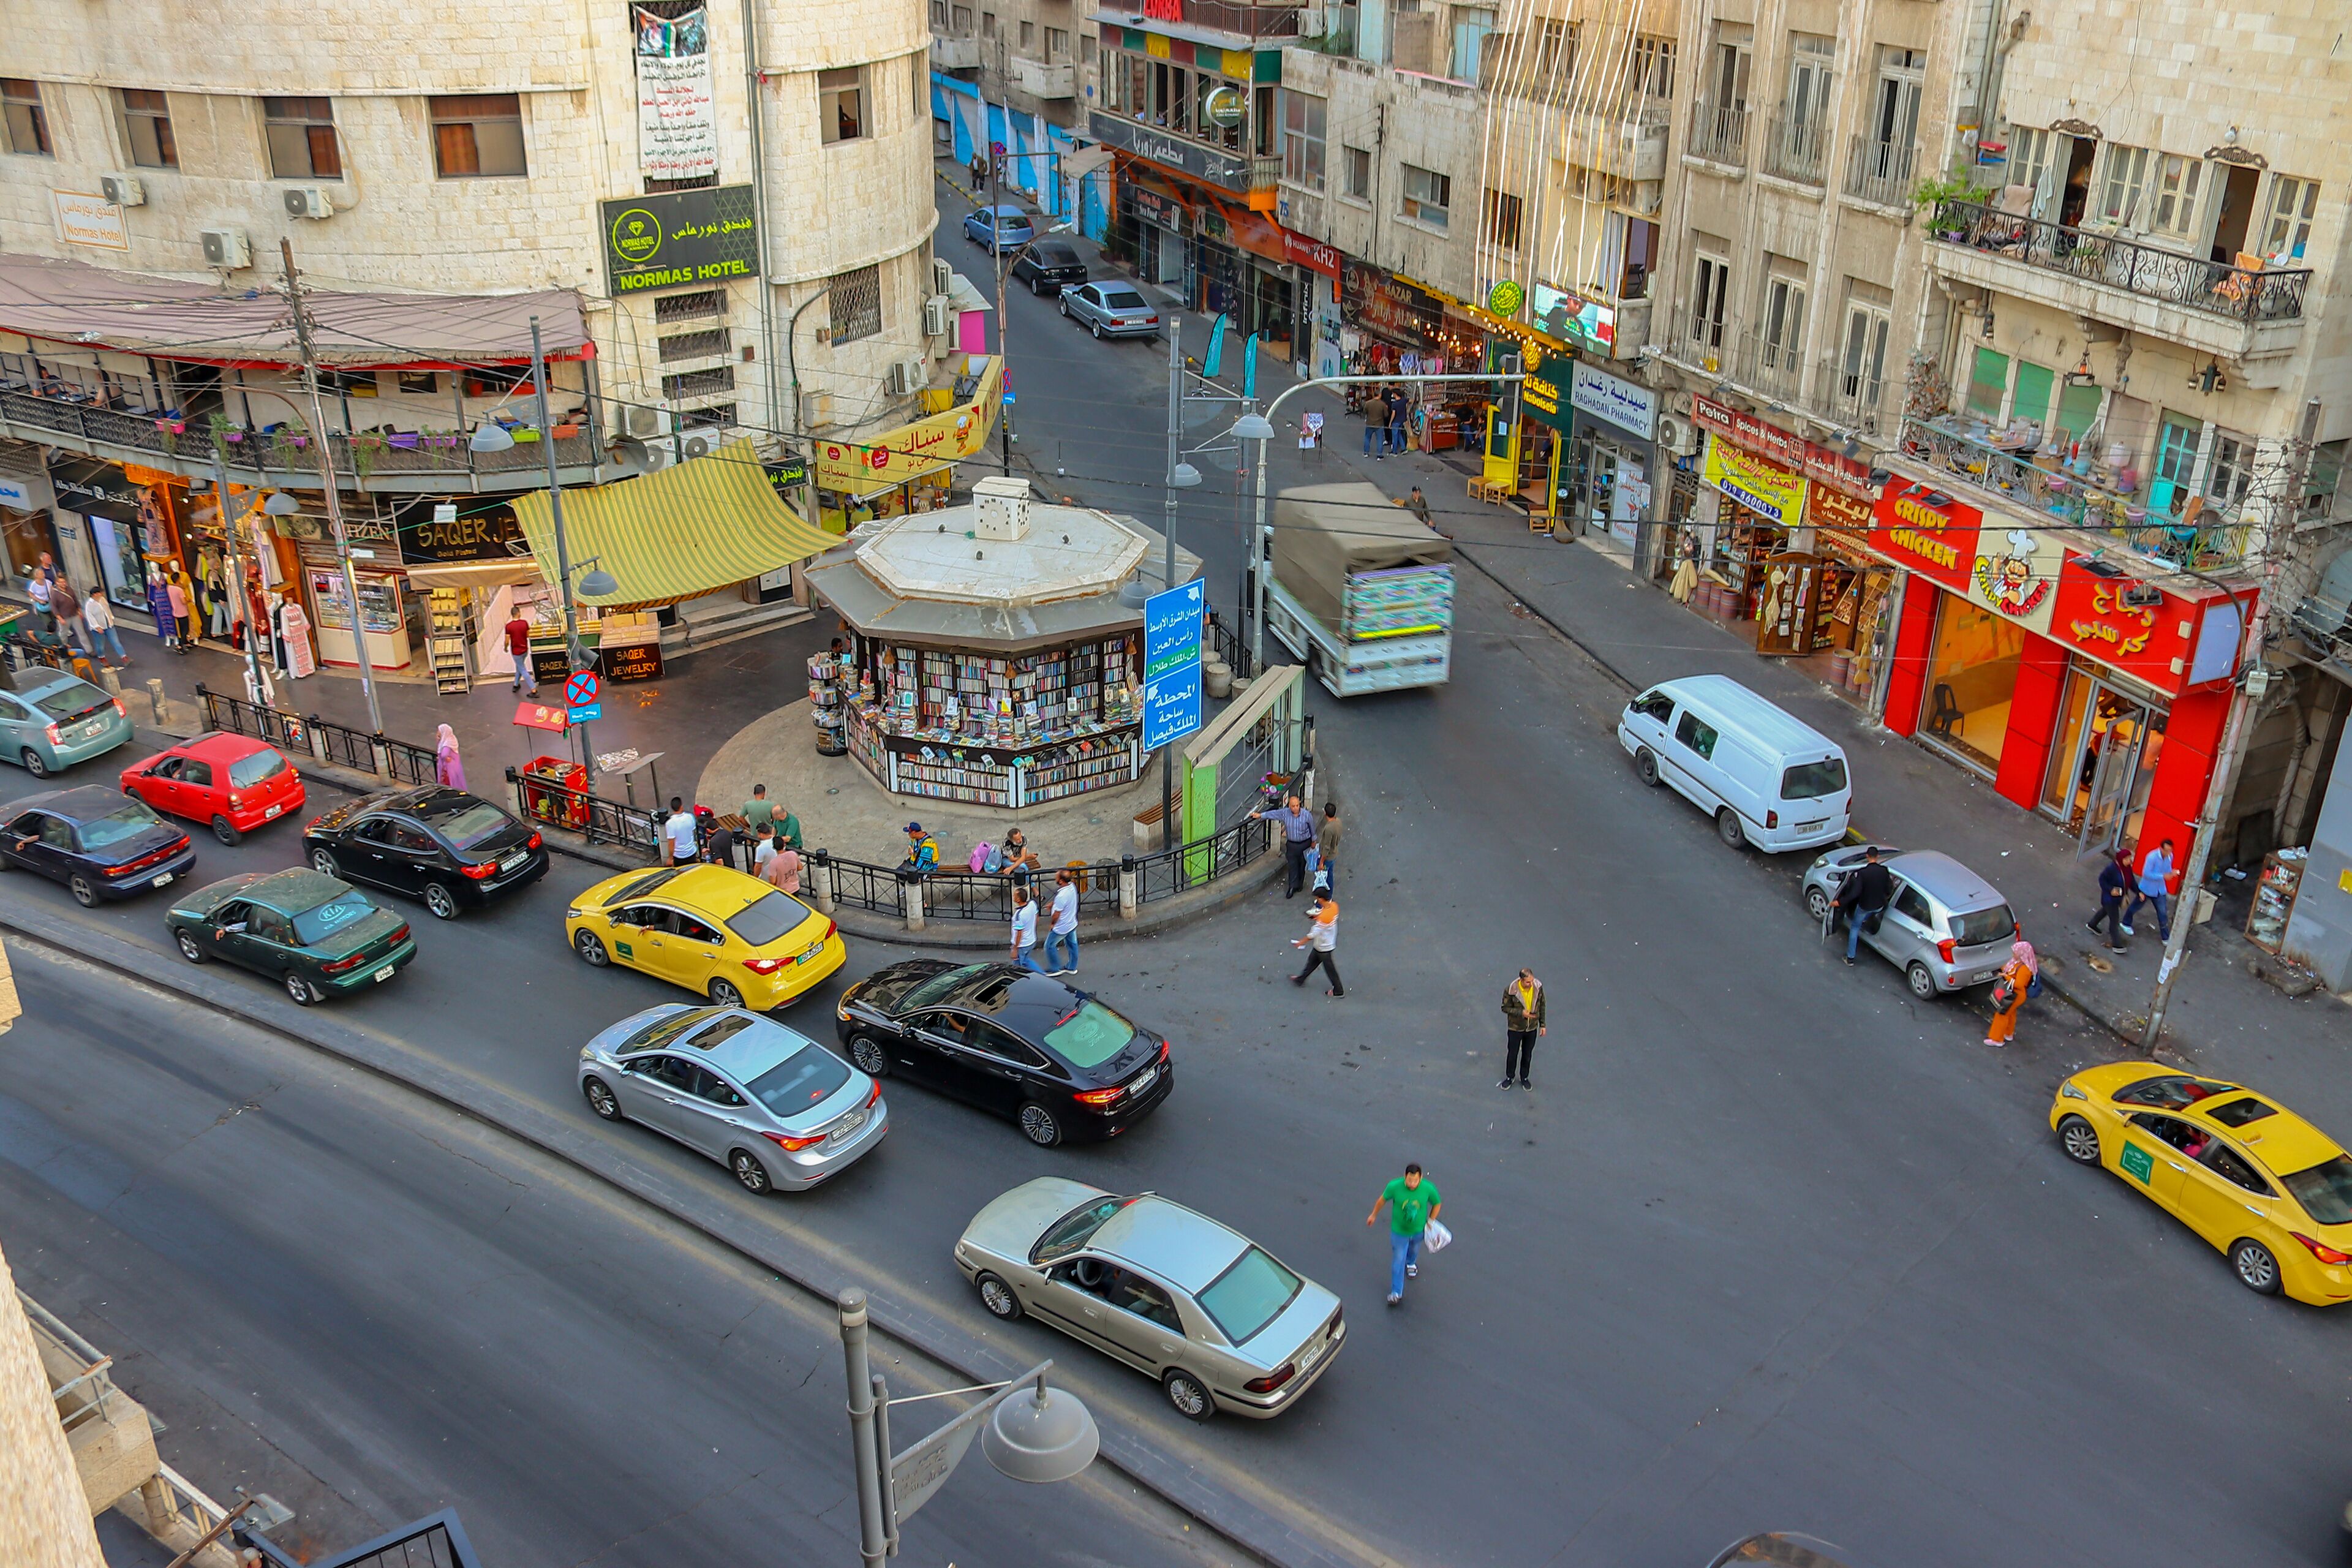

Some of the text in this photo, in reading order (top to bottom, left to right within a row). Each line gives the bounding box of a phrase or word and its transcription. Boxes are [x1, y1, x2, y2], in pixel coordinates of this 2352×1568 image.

[1133, 126, 1184, 165] مطعم زوربا
[1280, 200, 1289, 216] 75
[66, 224, 123, 242] Normas Hotel
[722, 217, 752, 235] فندق
[1292, 239, 1335, 268] HUAWEI KH2
[620, 260, 750, 290] NORMAS HOTEL
[1385, 284, 1412, 304] BAZAR
[1532, 377, 1558, 400] كنافة
[1578, 372, 1647, 413] صيدلية رغدان
[1575, 391, 1648, 431] RAGHADAN PHARMACY
[1698, 402, 1788, 449] Petra Spices & Herbs
[899, 429, 945, 454] سناك
[780, 466, 804, 484] فندق
[821, 464, 849, 477] سناك
[56, 479, 69, 490] Abu
[1894, 497, 1949, 535] CRISPY
[418, 518, 490, 547] SAQER
[1890, 525, 1959, 570] CHICKEN
[1148, 607, 1200, 633] ميدان الشرق الأوسط
[1153, 628, 1193, 655] رأس العين
[540, 661, 564, 671] SAQER
[616, 648, 646, 662] SAQER
[611, 662, 657, 677] JEWELRY
[1148, 663, 1167, 677] طلال
[1155, 683, 1195, 708] المحطة
[1158, 707, 1184, 724] ساحة
[1147, 714, 1196, 748] الملك فيصل
[322, 905, 343, 919] KIA
